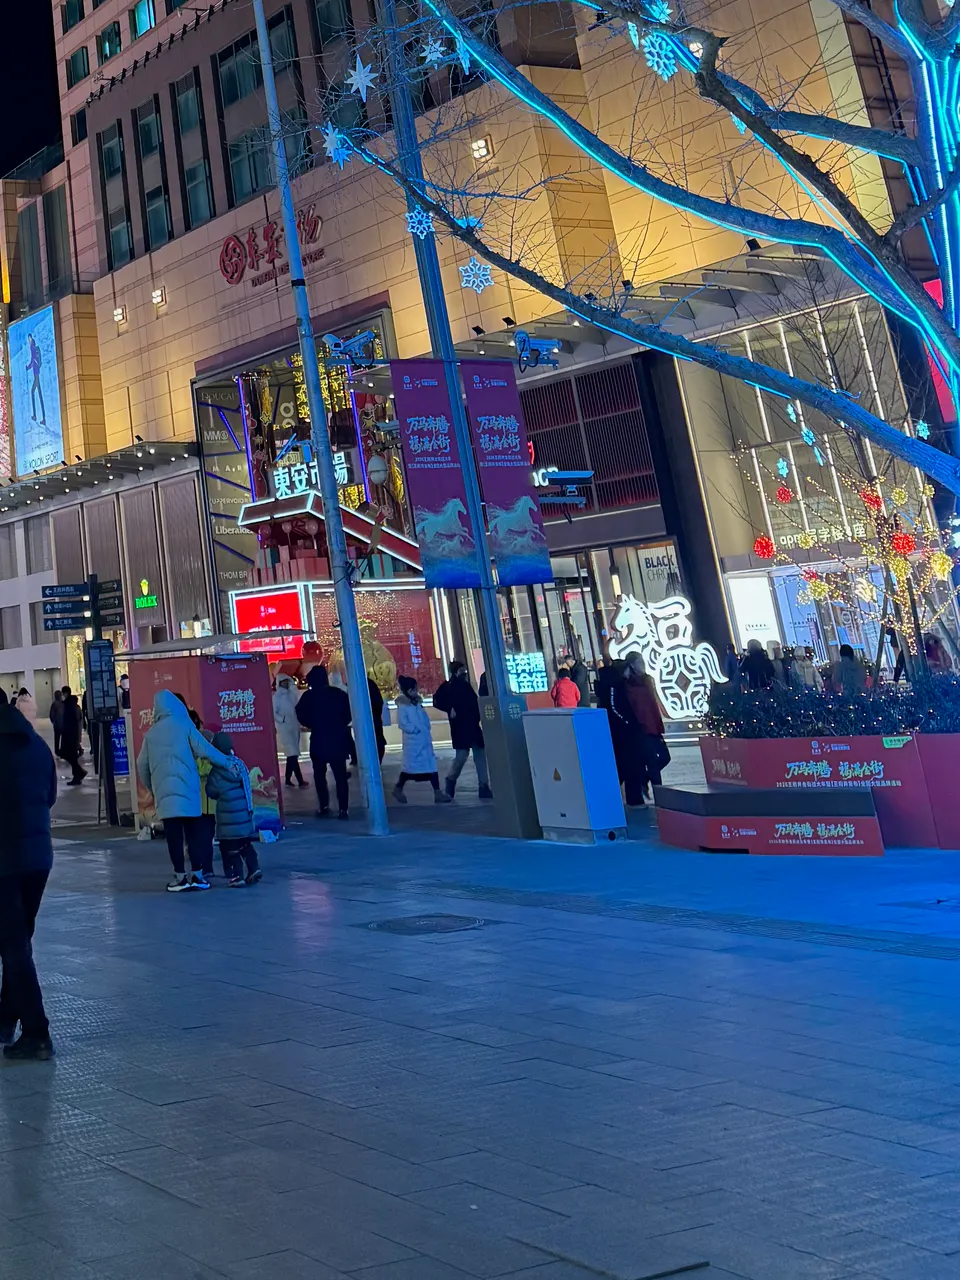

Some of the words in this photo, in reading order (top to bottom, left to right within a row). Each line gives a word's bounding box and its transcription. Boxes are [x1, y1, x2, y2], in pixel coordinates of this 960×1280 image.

[405, 414, 450, 436] 万马奔腾
[476, 414, 520, 434] 万马奔腾
[44, 450, 59, 465] SPORT
[644, 555, 675, 569] BLACK
[135, 595, 158, 609] ROLEX
[785, 761, 833, 782] 万马奔腾
